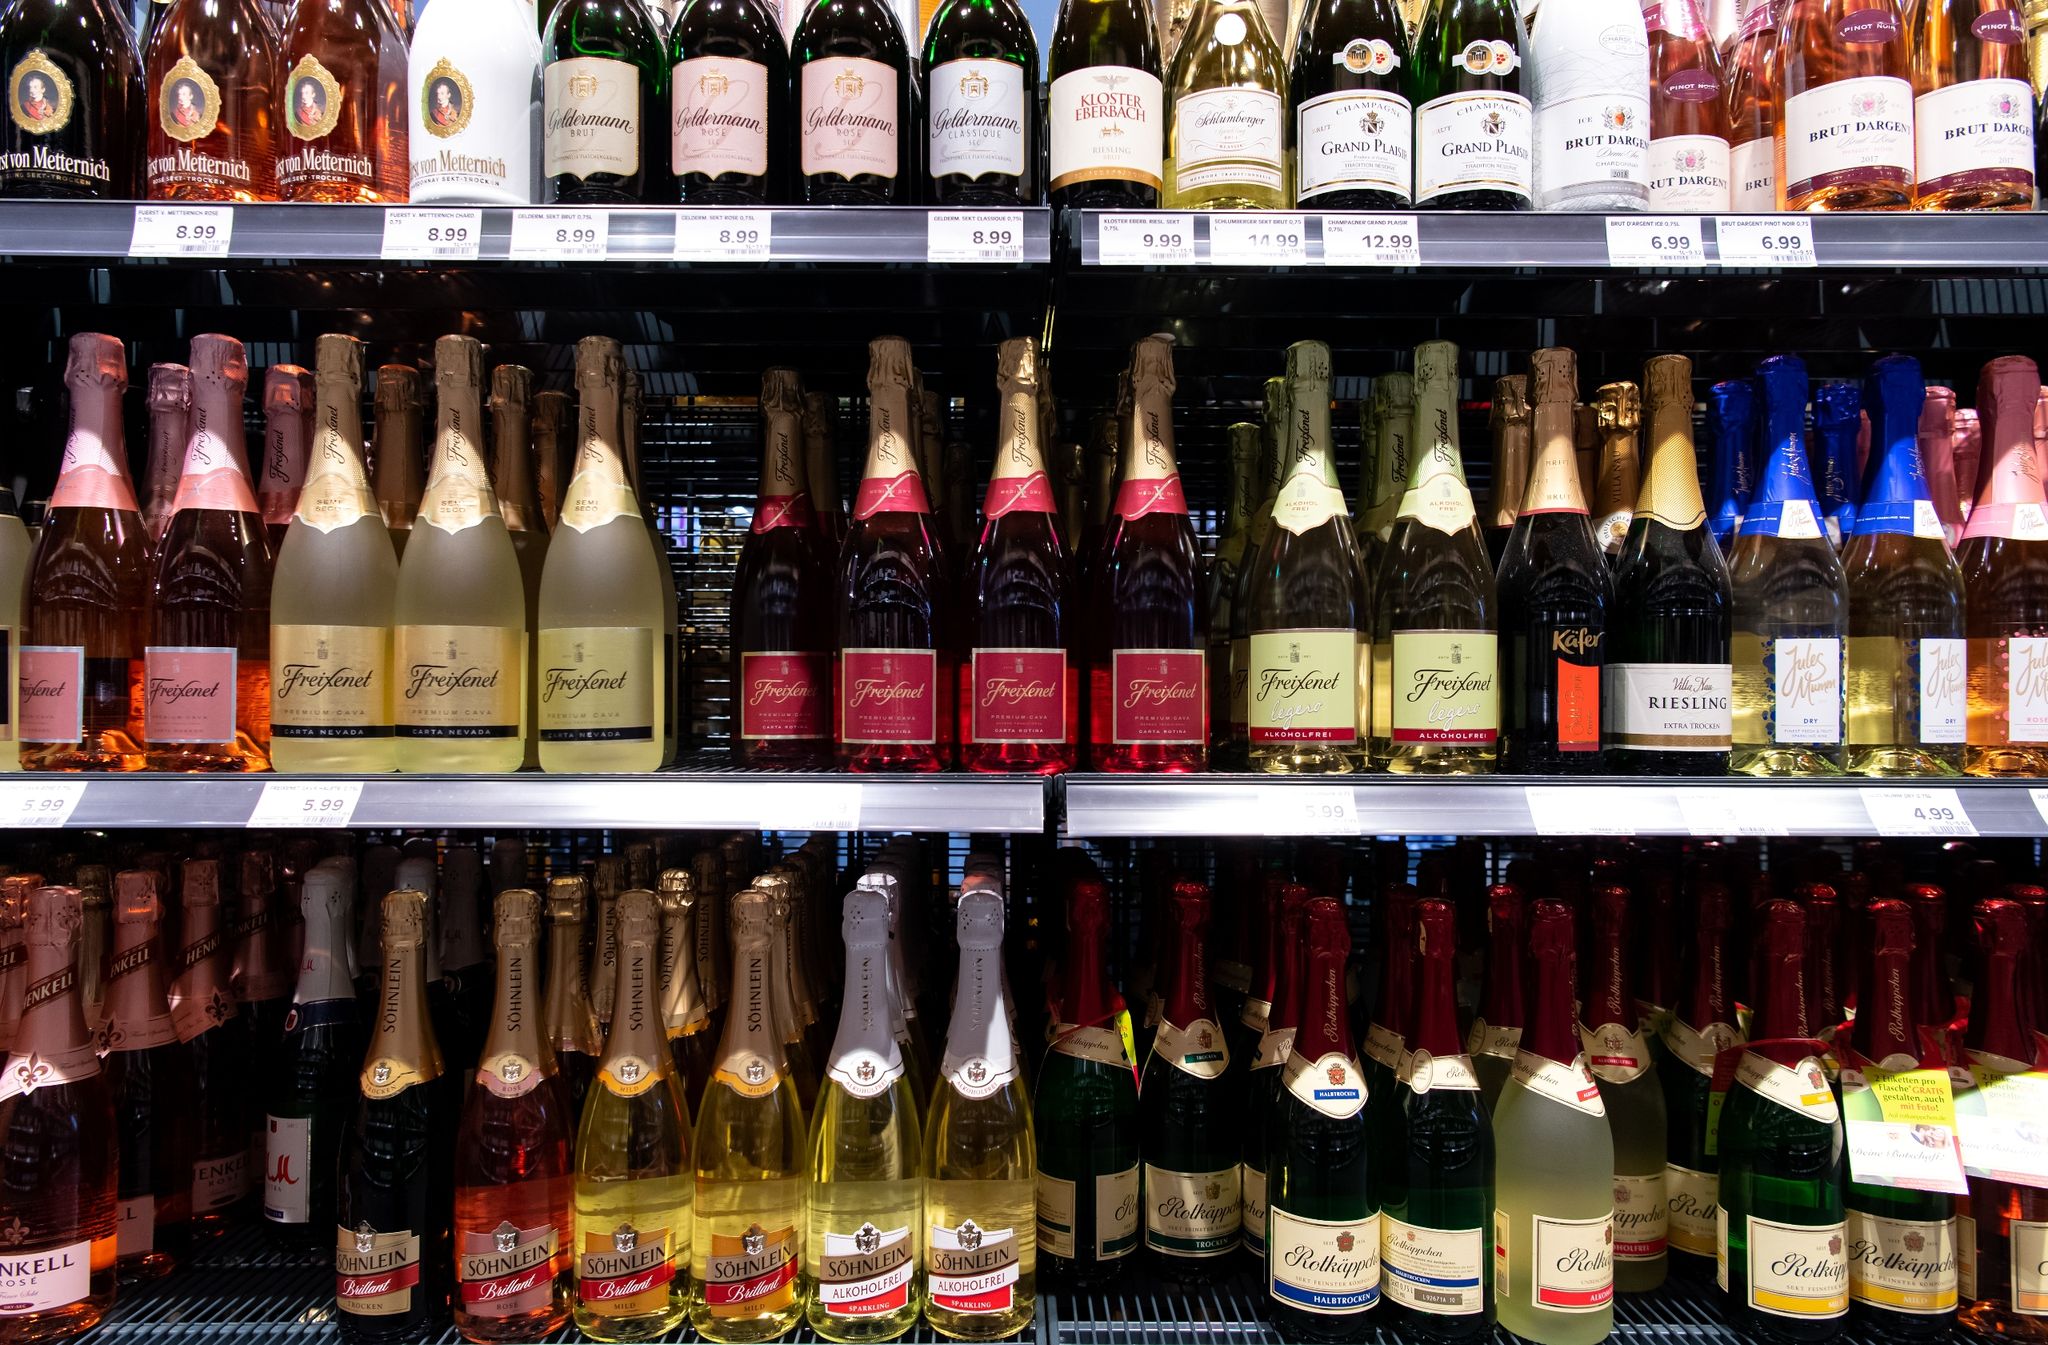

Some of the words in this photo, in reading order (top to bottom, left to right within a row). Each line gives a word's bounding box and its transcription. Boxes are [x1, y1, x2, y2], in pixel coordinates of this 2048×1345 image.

[1844, 23, 1872, 33] PINOT
[1980, 23, 2008, 31] PINOT
[1669, 83, 1695, 92] PINOT
[1080, 92, 1142, 109] KLOSTER
[546, 107, 636, 138] Geldermann
[673, 106, 765, 137] Geldermann
[804, 106, 896, 137] Geldermann
[1075, 105, 1146, 123] EBERBACH
[1195, 110, 1266, 129] Schlumberger
[1577, 115, 1593, 125] ICE
[931, 107, 1022, 139] Geldermann
[1808, 123, 1851, 144] BRUT
[1856, 119, 1911, 135] DARGENT
[570, 128, 596, 138] BRUT
[948, 128, 1001, 139] CLASSIQUE
[1943, 122, 1989, 142] BRUT
[1092, 146, 1132, 155] RIESLING
[1321, 140, 1370, 156] GRAND
[1374, 138, 1408, 162] PLAISIR
[1441, 141, 1492, 157] GRAND
[1496, 139, 1529, 162] PLAISIR
[1565, 135, 1604, 151] BRUT
[10, 152, 30, 169] von
[33, 145, 111, 182] Metternich
[158, 156, 176, 172] von
[178, 149, 251, 181] Metternich
[285, 156, 300, 172] von
[302, 147, 373, 177] Metternich
[421, 158, 438, 174] von
[439, 150, 507, 180] Metternich
[1860, 155, 1879, 164] 2017
[1612, 170, 1629, 180] 2018
[1679, 175, 1727, 190] DARGENT
[1214, 218, 1257, 226] SCHLUMBERGER
[1258, 218, 1272, 226] SEKT
[1273, 218, 1288, 226] BRUT
[1328, 219, 1365, 227] CHAMPAGNER
[1366, 219, 1386, 227] GRAND
[1610, 220, 1626, 228] BRUT
[1721, 220, 1736, 228] BRUT
[1763, 220, 1780, 228] PINOT
[1781, 220, 1796, 228] NOIR
[176, 225, 216, 241] 8.99
[428, 227, 468, 243] 8.99
[556, 229, 596, 244] 8.99
[719, 229, 759, 244] 8.99
[972, 230, 1012, 245] 8.99
[1143, 233, 1182, 249] 9.99
[1361, 234, 1412, 249] 12.99
[1651, 235, 1690, 251] 6.99
[1761, 235, 1801, 251] 6.99
[191, 406, 213, 465] Freixenet
[323, 404, 346, 464] Freixenet
[447, 406, 469, 466] Freixenet
[583, 405, 605, 464] Freixenet
[877, 407, 900, 465] Freixenet
[1013, 409, 1034, 468] Freixenet
[1146, 411, 1169, 471] Freixenet
[1295, 408, 1317, 467] Freixenet
[1434, 408, 1456, 467] Freixenet
[269, 428, 290, 483] Freixenet
[1392, 432, 1410, 483] Freixenet
[574, 505, 598, 513] SECO
[575, 499, 600, 507] SEMI
[1429, 500, 1465, 508] ALKOHOL
[1552, 626, 1606, 656] Käfer
[1781, 643, 1828, 698] Jules
[278, 663, 374, 700] Freixenet
[405, 663, 499, 700] Freixenet
[542, 667, 628, 704] Freixenet
[1256, 667, 1341, 702] Freixenet
[1406, 667, 1493, 703] Freixenet
[1672, 676, 1693, 692] Villa
[1693, 676, 1714, 692] Nau
[148, 677, 221, 706] Freixenet
[750, 678, 818, 706] Freixenet
[850, 678, 926, 708] Freixenet
[981, 677, 1057, 708] Freixenet
[1123, 679, 1198, 710] Freixenet
[1647, 696, 1728, 711] RIESLING
[282, 709, 330, 717] PREMIUM
[336, 709, 366, 717] CAVA
[411, 708, 458, 717] PREMIUM
[465, 708, 493, 717] CAVA
[546, 711, 588, 720] PREMIUM
[592, 711, 621, 719] CAVA
[1663, 722, 1688, 730] EXTRA
[1689, 722, 1721, 731] TROCKEN
[1803, 717, 1819, 726] DRY
[1945, 717, 1957, 726] DRY
[284, 728, 314, 737] CARTA
[319, 728, 365, 737] NEVADA
[412, 728, 444, 737] CARTA
[448, 728, 492, 737] NEVADA
[578, 730, 622, 740] NEVADA
[1264, 730, 1333, 739] ALKOHOLFREI
[1418, 731, 1488, 740] ALKOHOLFREI
[21, 798, 65, 813] 5.99
[302, 798, 344, 813] 5.99
[1914, 806, 1955, 822] 4.99
[603, 905, 617, 968] SÖHNLEIN
[660, 925, 674, 993] SÖHNLEIN
[1606, 945, 1622, 1015] Rotkäppchen
[382, 958, 402, 1034] SÖHNLEIN
[507, 956, 523, 1033] SÖHNLEIN
[630, 956, 645, 1032] SÖHNLEIN
[748, 957, 762, 1033] SÖHNLEIN
[1322, 967, 1343, 1043] Rotkäppchen
[1887, 968, 1907, 1042] Rotkäppchen
[747, 1085, 768, 1094] MILD
[845, 1080, 888, 1095] ALKOHOLFREI
[955, 1080, 999, 1097] ALKOHOLFREI
[1881, 1074, 1920, 1086] Etiketten
[1921, 1078, 1936, 1088] pro
[1318, 1089, 1357, 1098] HALBTROCKEN
[1912, 1086, 1945, 1096] GRATIS
[1924, 1094, 1946, 1105] auch
[1900, 1102, 1915, 1111] mit
[1386, 1232, 1444, 1258] Rotkäppchen
[338, 1246, 408, 1273] SÖHNLEIN
[468, 1240, 550, 1276] SÖHNLEIN
[586, 1243, 666, 1276] SÖHNLEIN
[714, 1241, 792, 1279] SÖHNLEIN
[828, 1247, 907, 1278] SÖHNLEIN
[934, 1245, 1010, 1271] SÖHNLEIN
[937, 1272, 1006, 1293] ALKOHOLFREI
[1394, 1268, 1432, 1285] HALBTROCKEN
[342, 1278, 391, 1298] Brillant
[478, 1273, 536, 1301] Brillant
[597, 1274, 653, 1300] Brillant
[726, 1278, 782, 1303] Brillant
[832, 1272, 903, 1300] ALKOHOLFREI
[347, 1301, 384, 1311] TROCKEN
[613, 1302, 636, 1311] MILD
[848, 1302, 890, 1313] SPARKLING
[950, 1299, 992, 1310] SPARKLING
[1313, 1292, 1371, 1306] HALBTROCKEN
[1902, 1296, 1928, 1305] MILD
[742, 1303, 766, 1313] MILD
